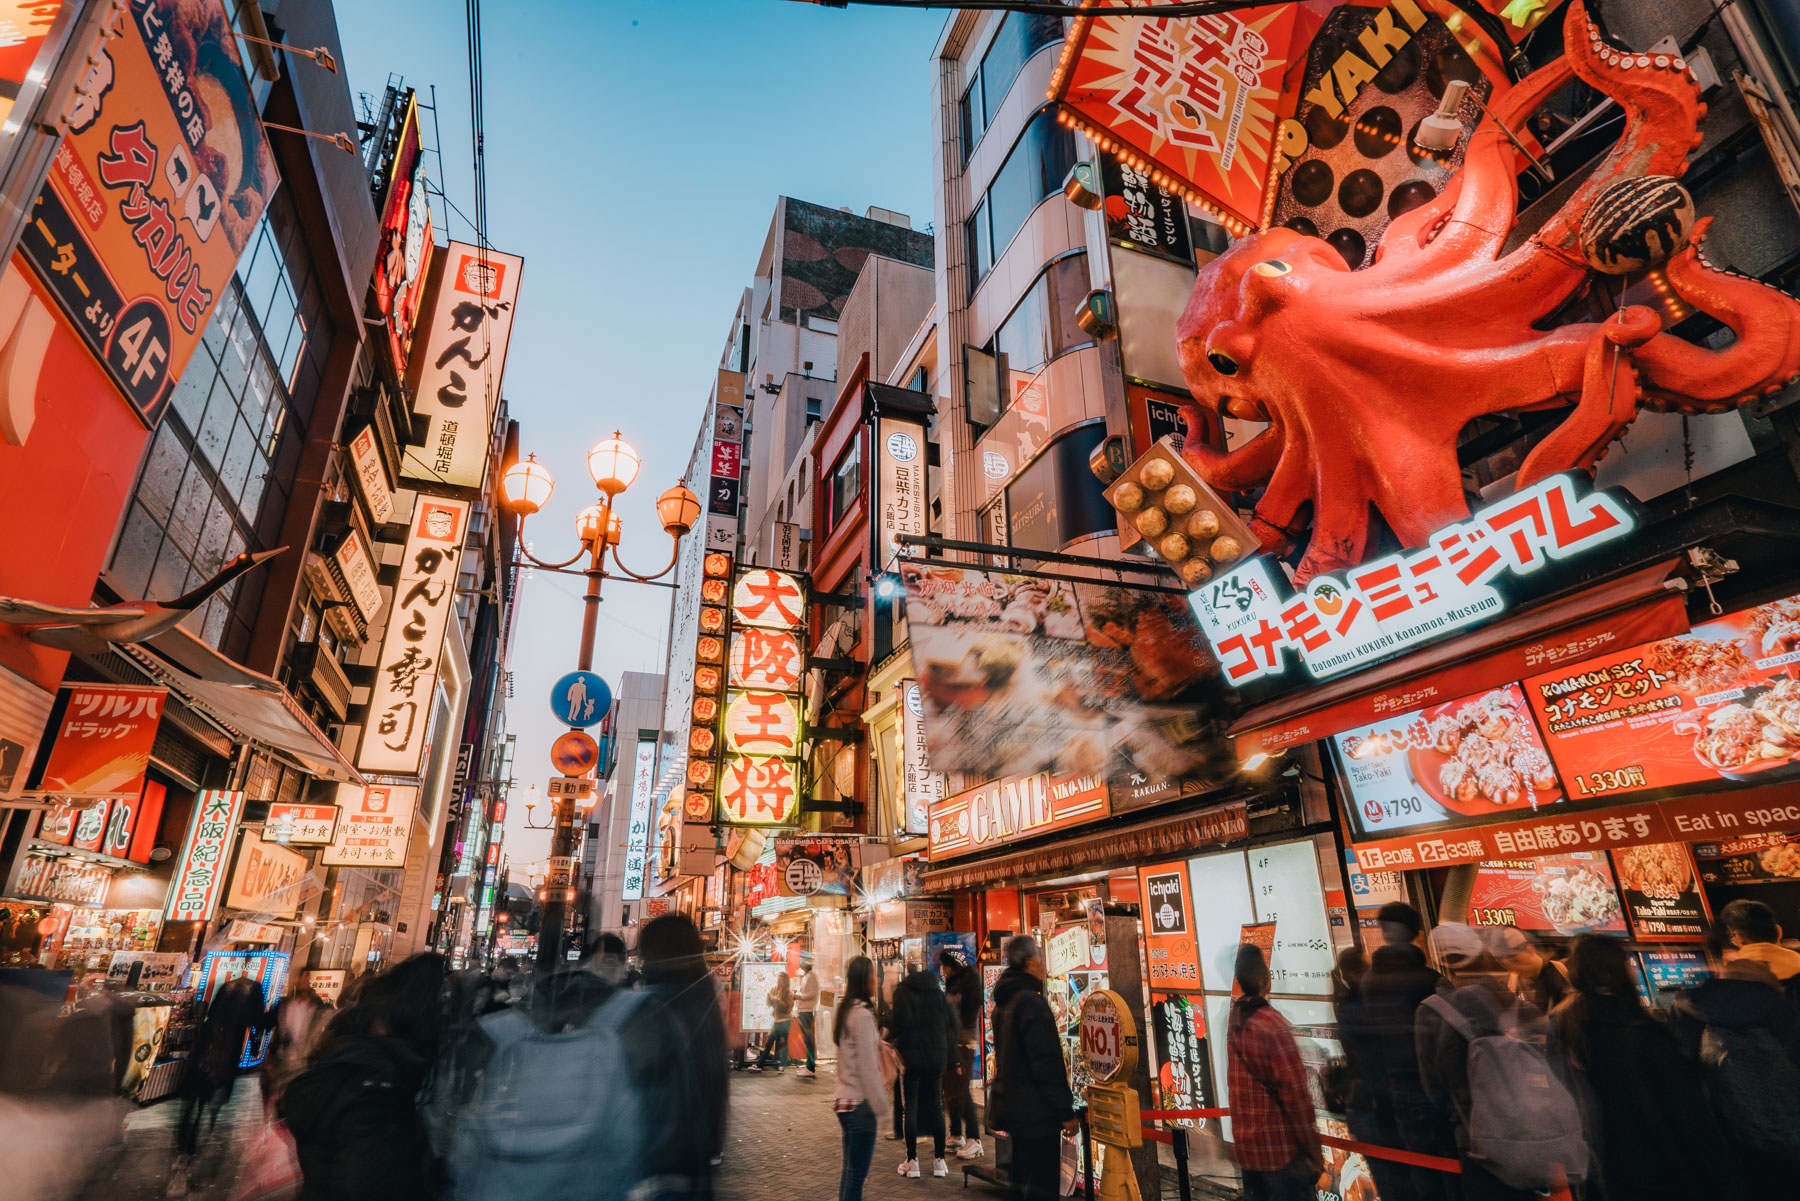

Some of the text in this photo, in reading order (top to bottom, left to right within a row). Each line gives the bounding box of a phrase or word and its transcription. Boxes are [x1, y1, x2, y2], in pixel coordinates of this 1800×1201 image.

[1276, 0, 1428, 173] OYAKI
[57, 145, 103, 223] 道頓堀店
[1080, 168, 1091, 185] 2
[98, 119, 212, 334] タッカルビ
[1095, 300, 1103, 315] 1
[120, 316, 166, 387] 4F
[434, 300, 512, 408] がんこ
[433, 419, 459, 474] 道頓堀店
[896, 467, 910, 533] 豆柴カフェ
[913, 465, 921, 518] MAMESHIBA
[886, 503, 895, 530] 大阪店
[1011, 501, 1045, 535] MITSUBA
[1217, 485, 1621, 680] コナモンミュージアム
[1226, 611, 1257, 632] KUKURU
[1311, 596, 1497, 673] Dotonbori KUKURU Konamon-Museum
[725, 569, 805, 821] 大阪王将
[1540, 659, 1644, 697] KONAMON SET
[74, 694, 159, 720] ツルハ
[1545, 669, 1667, 722] コナモンセット
[64, 722, 138, 739] ドラッグ
[446, 750, 469, 823] TSUTAYA
[550, 781, 593, 794] 自動車
[635, 768, 649, 812] 本場の味
[907, 763, 917, 793] 大阪店
[1353, 766, 1392, 783] Tako-Yaki
[1575, 768, 1647, 795] 1,330円
[289, 807, 316, 820] 地階
[970, 771, 1102, 844] GAME NIKO-NIKO
[1384, 796, 1422, 817] ¥790
[1674, 814, 1714, 832] Eat
[1716, 811, 1738, 827] in
[1494, 812, 1651, 854] 自由席あります
[179, 798, 231, 912] 大阪紀念品
[338, 848, 396, 861] 寿司・和食
[626, 820, 646, 891] かに道楽
[1258, 858, 1269, 869] 4F
[1262, 885, 1273, 896] 3F
[1634, 905, 1667, 916] Tako-Yaki
[309, 981, 339, 990] 会お座敷
[1151, 963, 1197, 979] お好み焼き
[1083, 1023, 1121, 1058] NO.1
